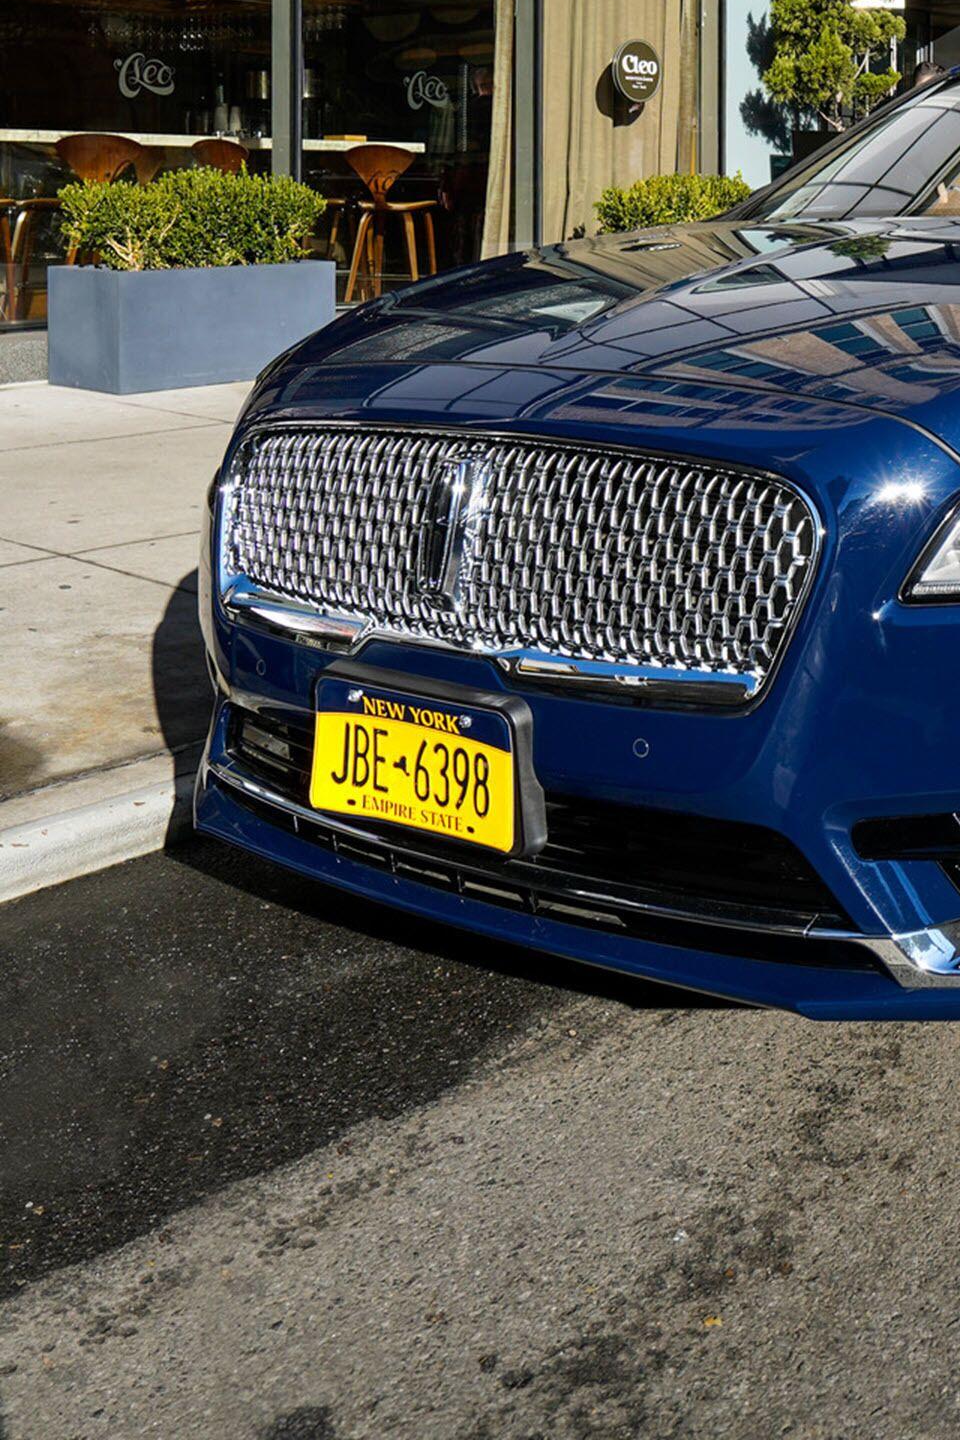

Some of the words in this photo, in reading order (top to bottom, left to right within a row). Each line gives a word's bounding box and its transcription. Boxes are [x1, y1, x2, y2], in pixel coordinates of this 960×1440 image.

[622, 54, 658, 75] Cleo
[362, 695, 404, 720] NEW
[408, 706, 461, 734] YORK
[361, 794, 415, 820] EMPIRE
[420, 810, 463, 833] STATE
